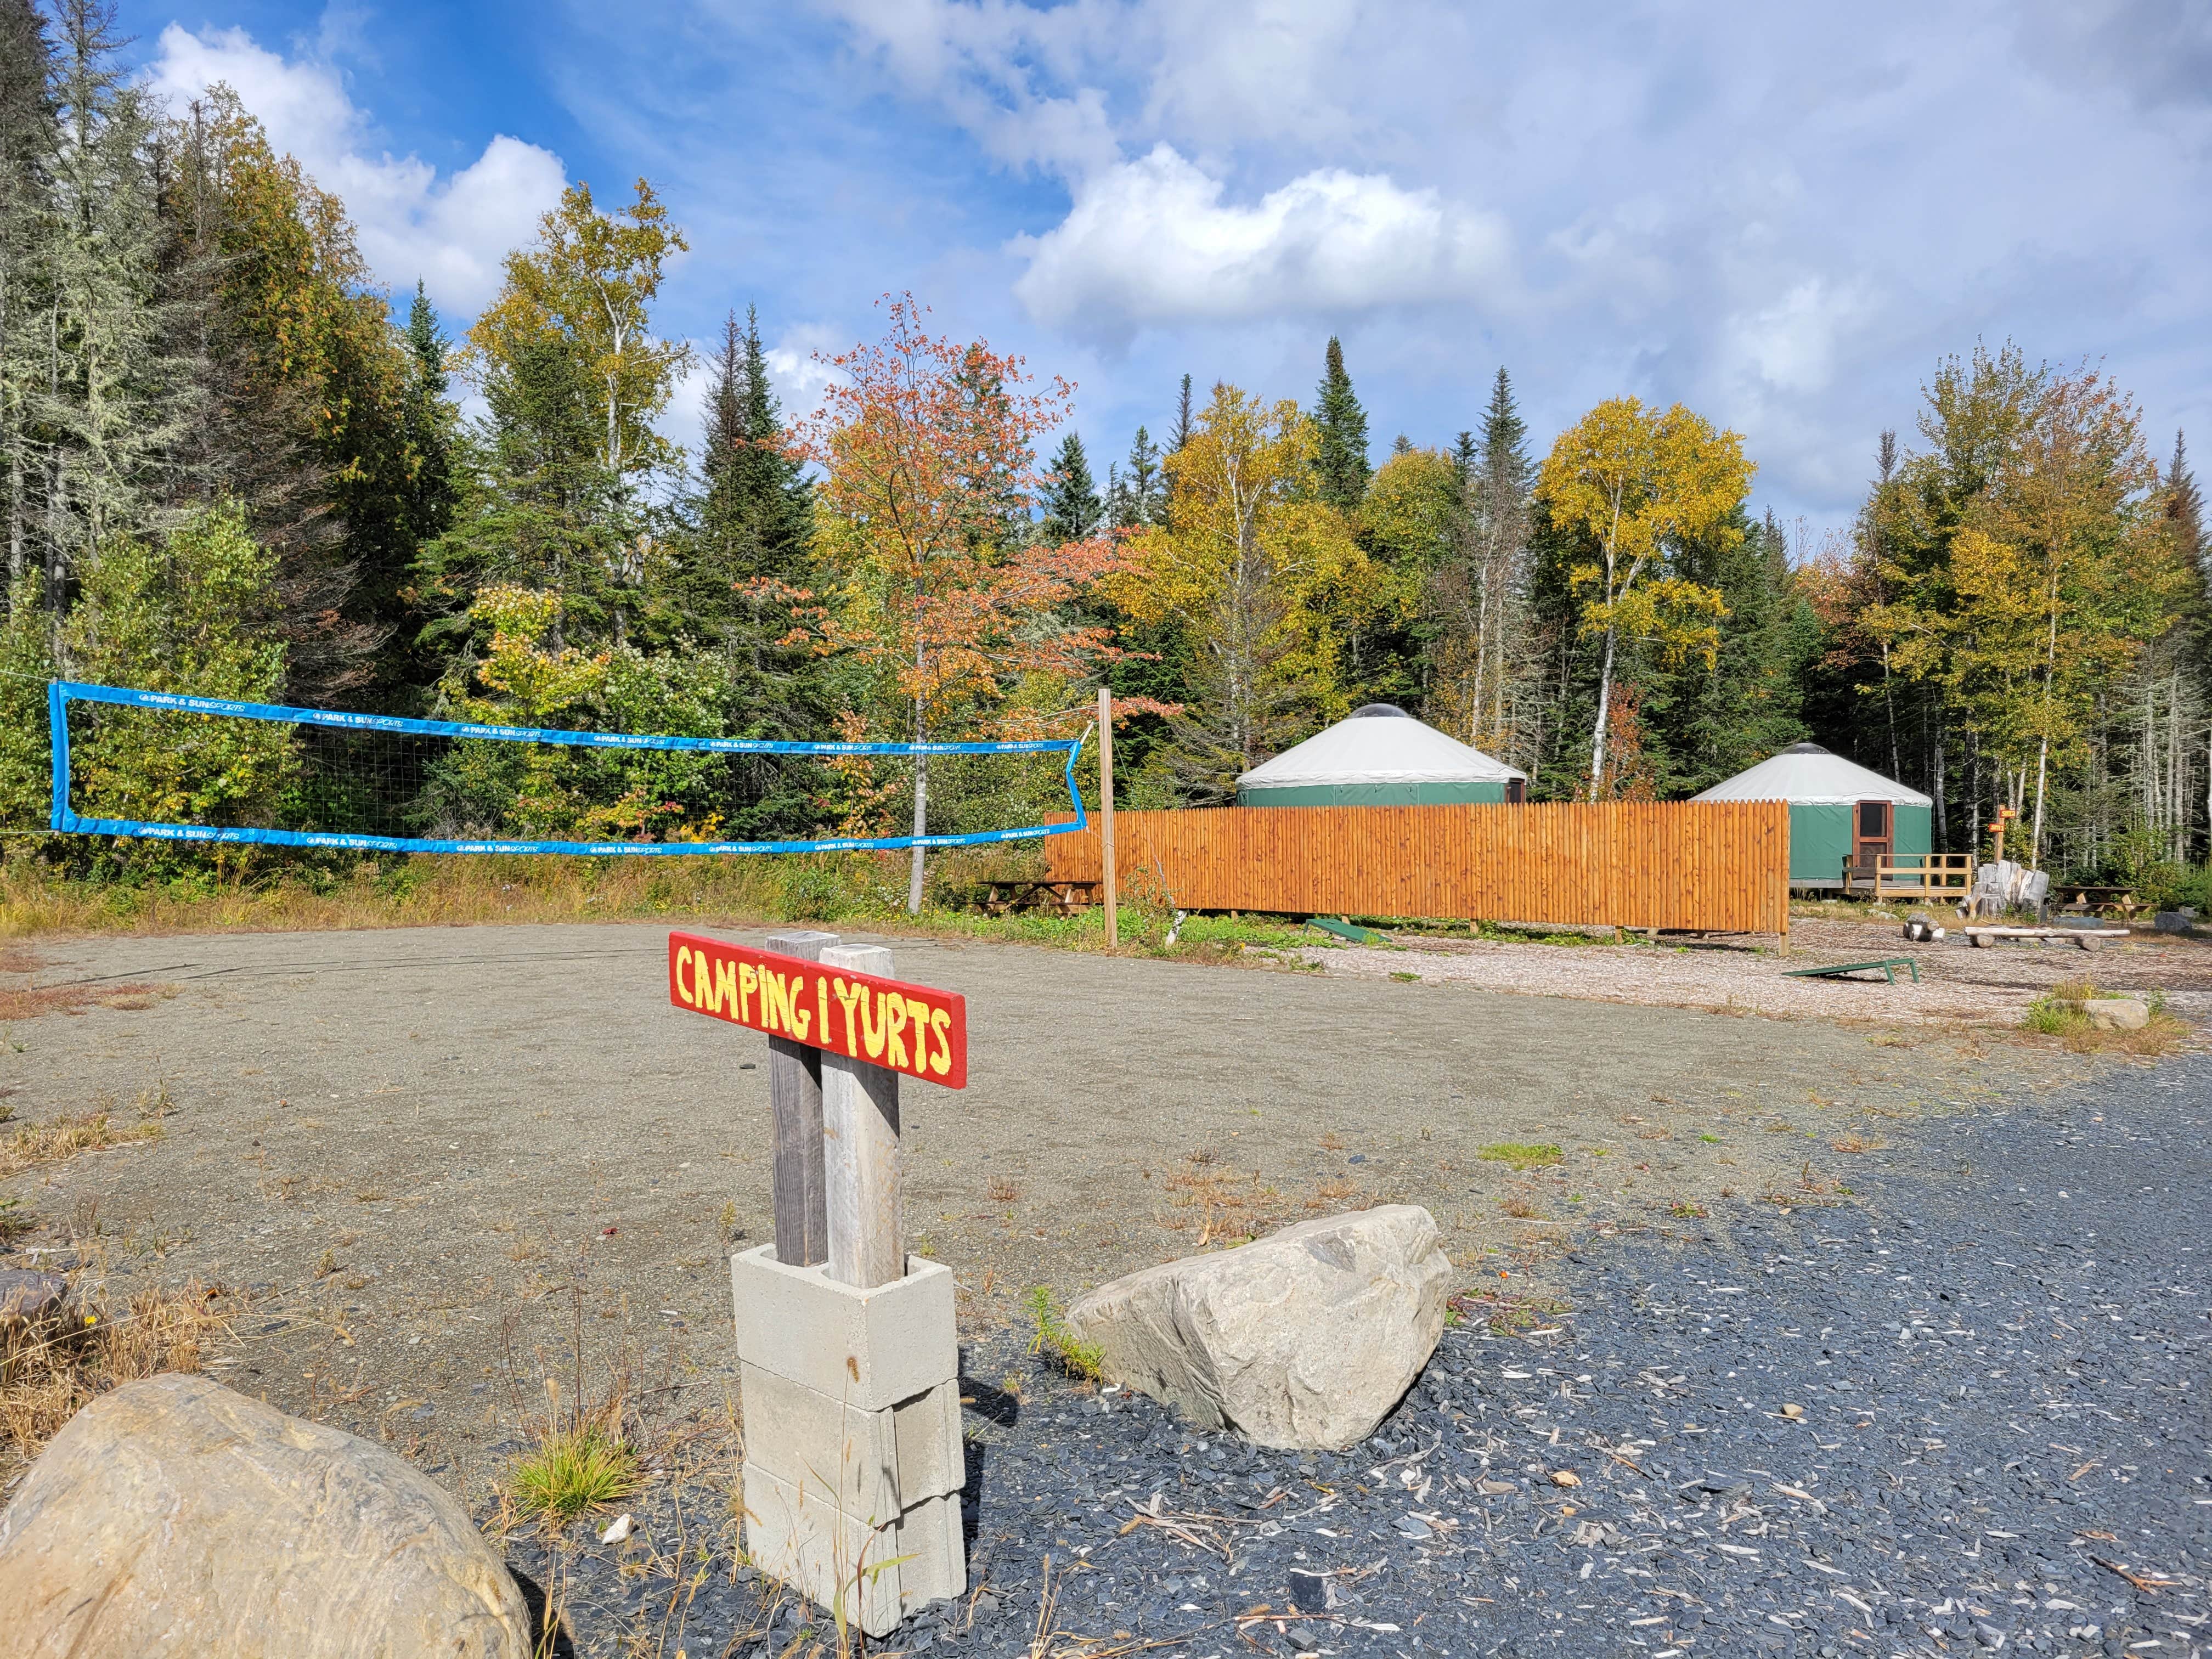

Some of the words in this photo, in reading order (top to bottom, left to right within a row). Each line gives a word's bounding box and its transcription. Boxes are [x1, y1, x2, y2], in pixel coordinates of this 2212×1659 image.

[150, 695, 177, 704] PARK
[322, 713, 346, 722] PARK
[471, 726, 492, 735] PARK
[149, 828, 175, 837] PARK
[676, 945, 811, 1040] CAMPING
[833, 977, 951, 1076] YURTS
